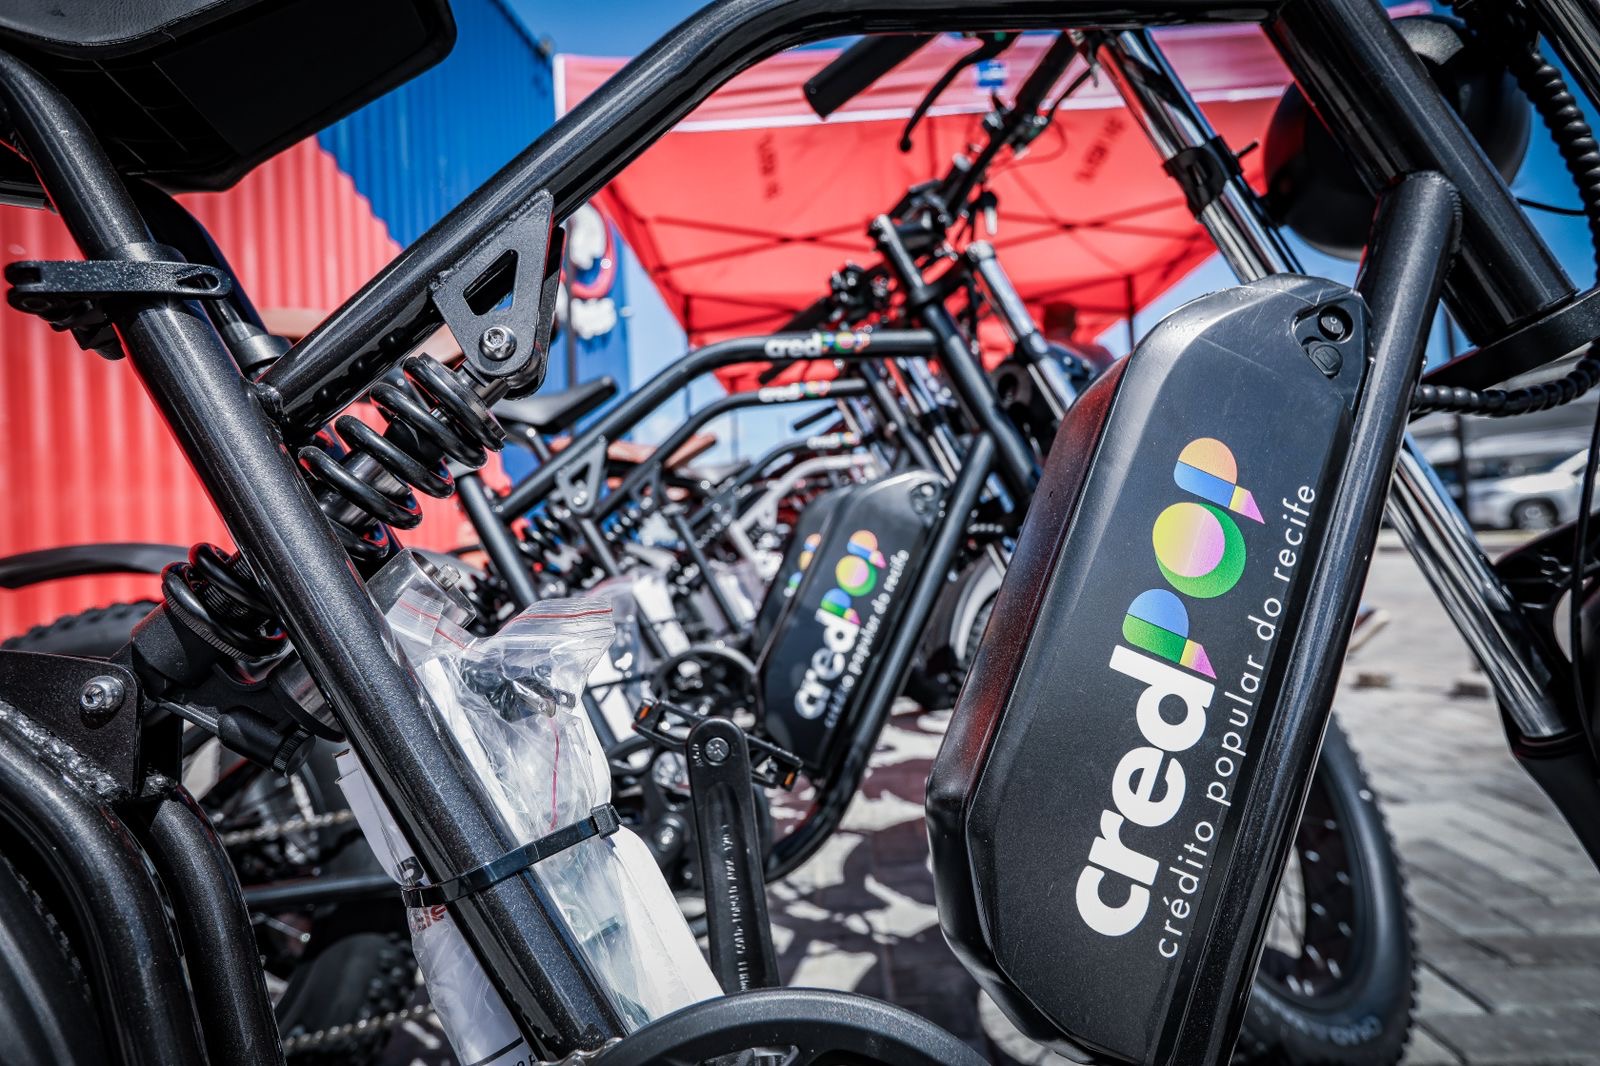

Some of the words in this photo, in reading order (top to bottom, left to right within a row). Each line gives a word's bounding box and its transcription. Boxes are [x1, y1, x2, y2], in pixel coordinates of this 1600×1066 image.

[1158, 821, 1215, 958] crédito
[1206, 655, 1264, 807] popular
[1247, 597, 1282, 641] do
[1273, 485, 1316, 582] recife
